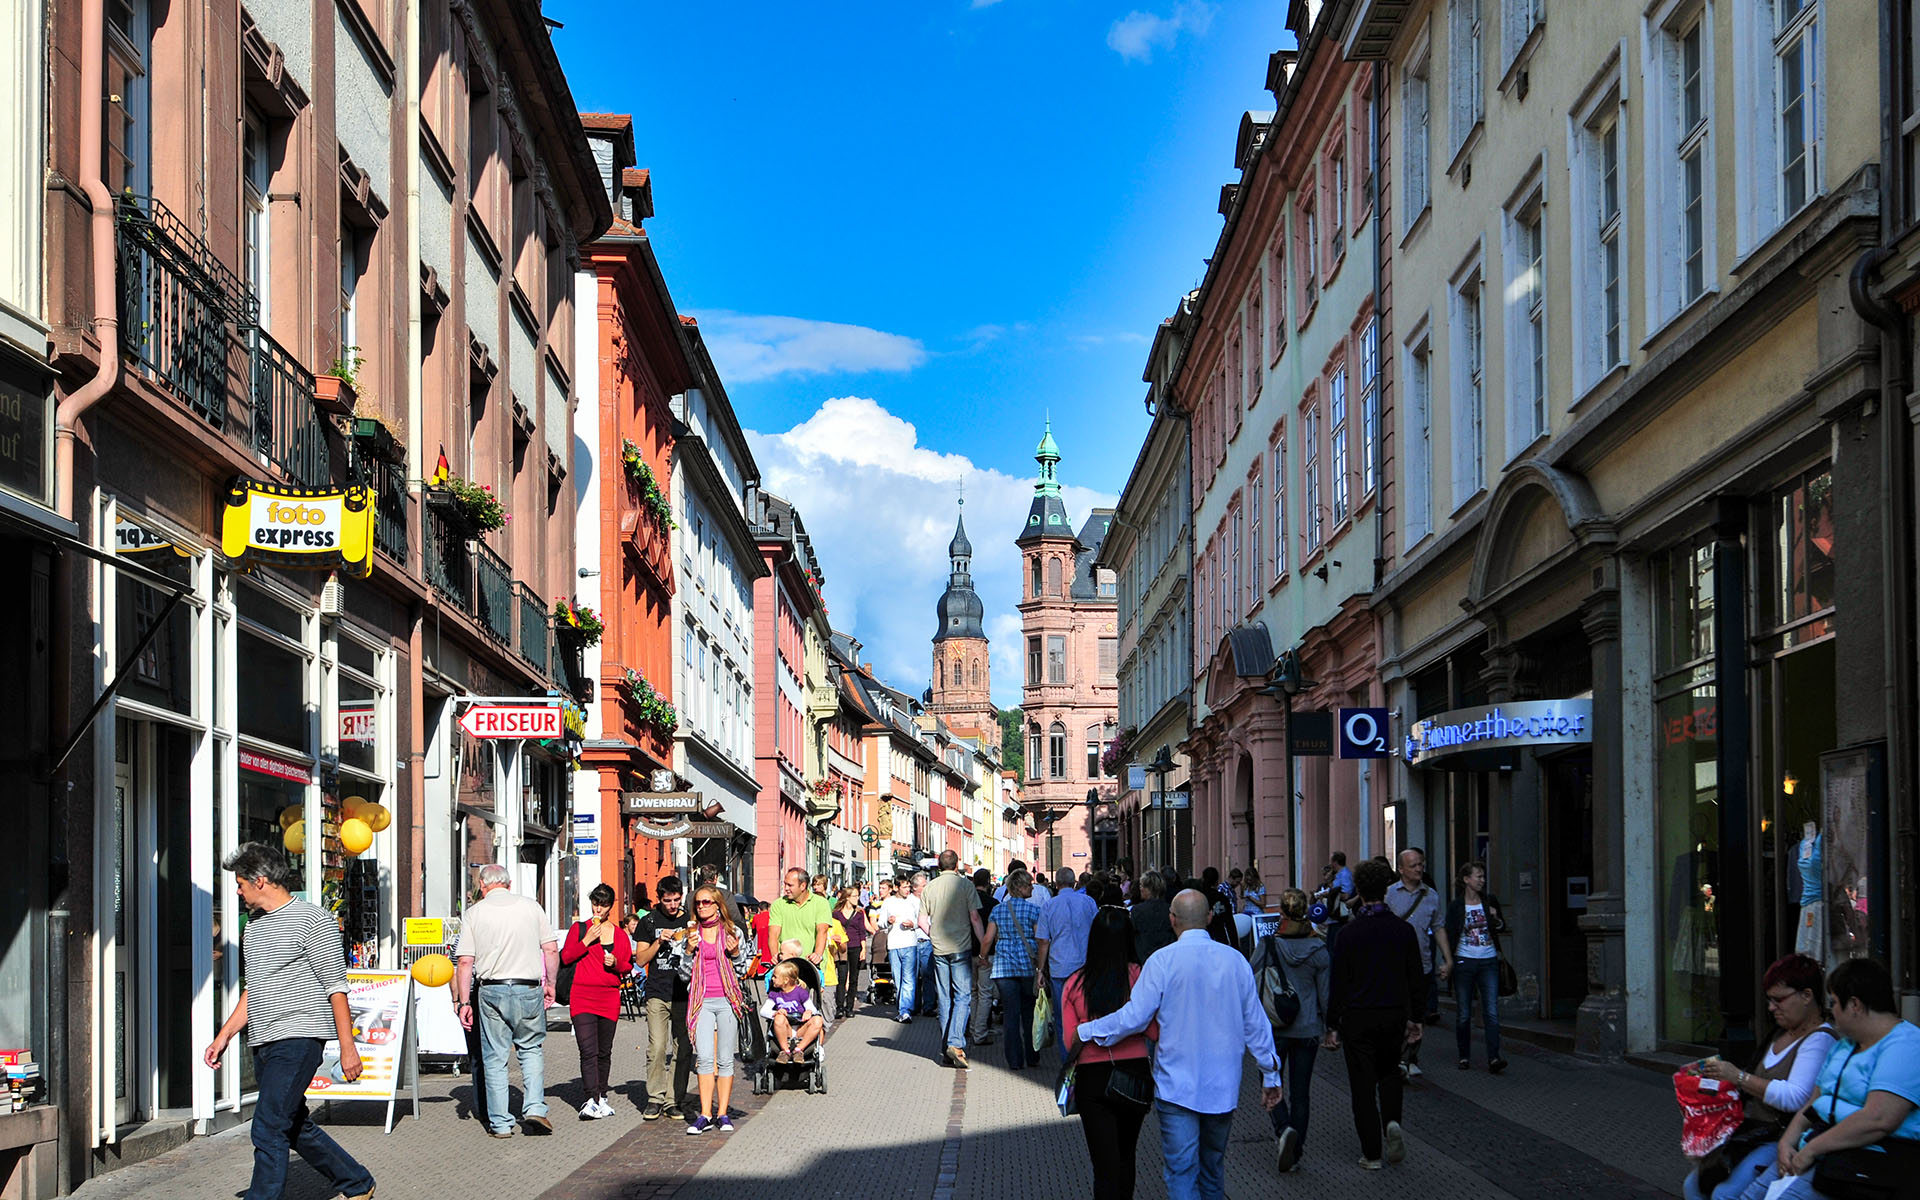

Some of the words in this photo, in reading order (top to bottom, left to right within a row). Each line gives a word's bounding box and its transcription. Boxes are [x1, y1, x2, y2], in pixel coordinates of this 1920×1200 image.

[0, 432, 20, 461] uf
[267, 501, 326, 525] foto
[255, 527, 335, 548] express
[475, 712, 556, 732] FRISEUR
[1420, 708, 1585, 751] Zimmertheater
[630, 797, 696, 808] LÖWENBRÄU
